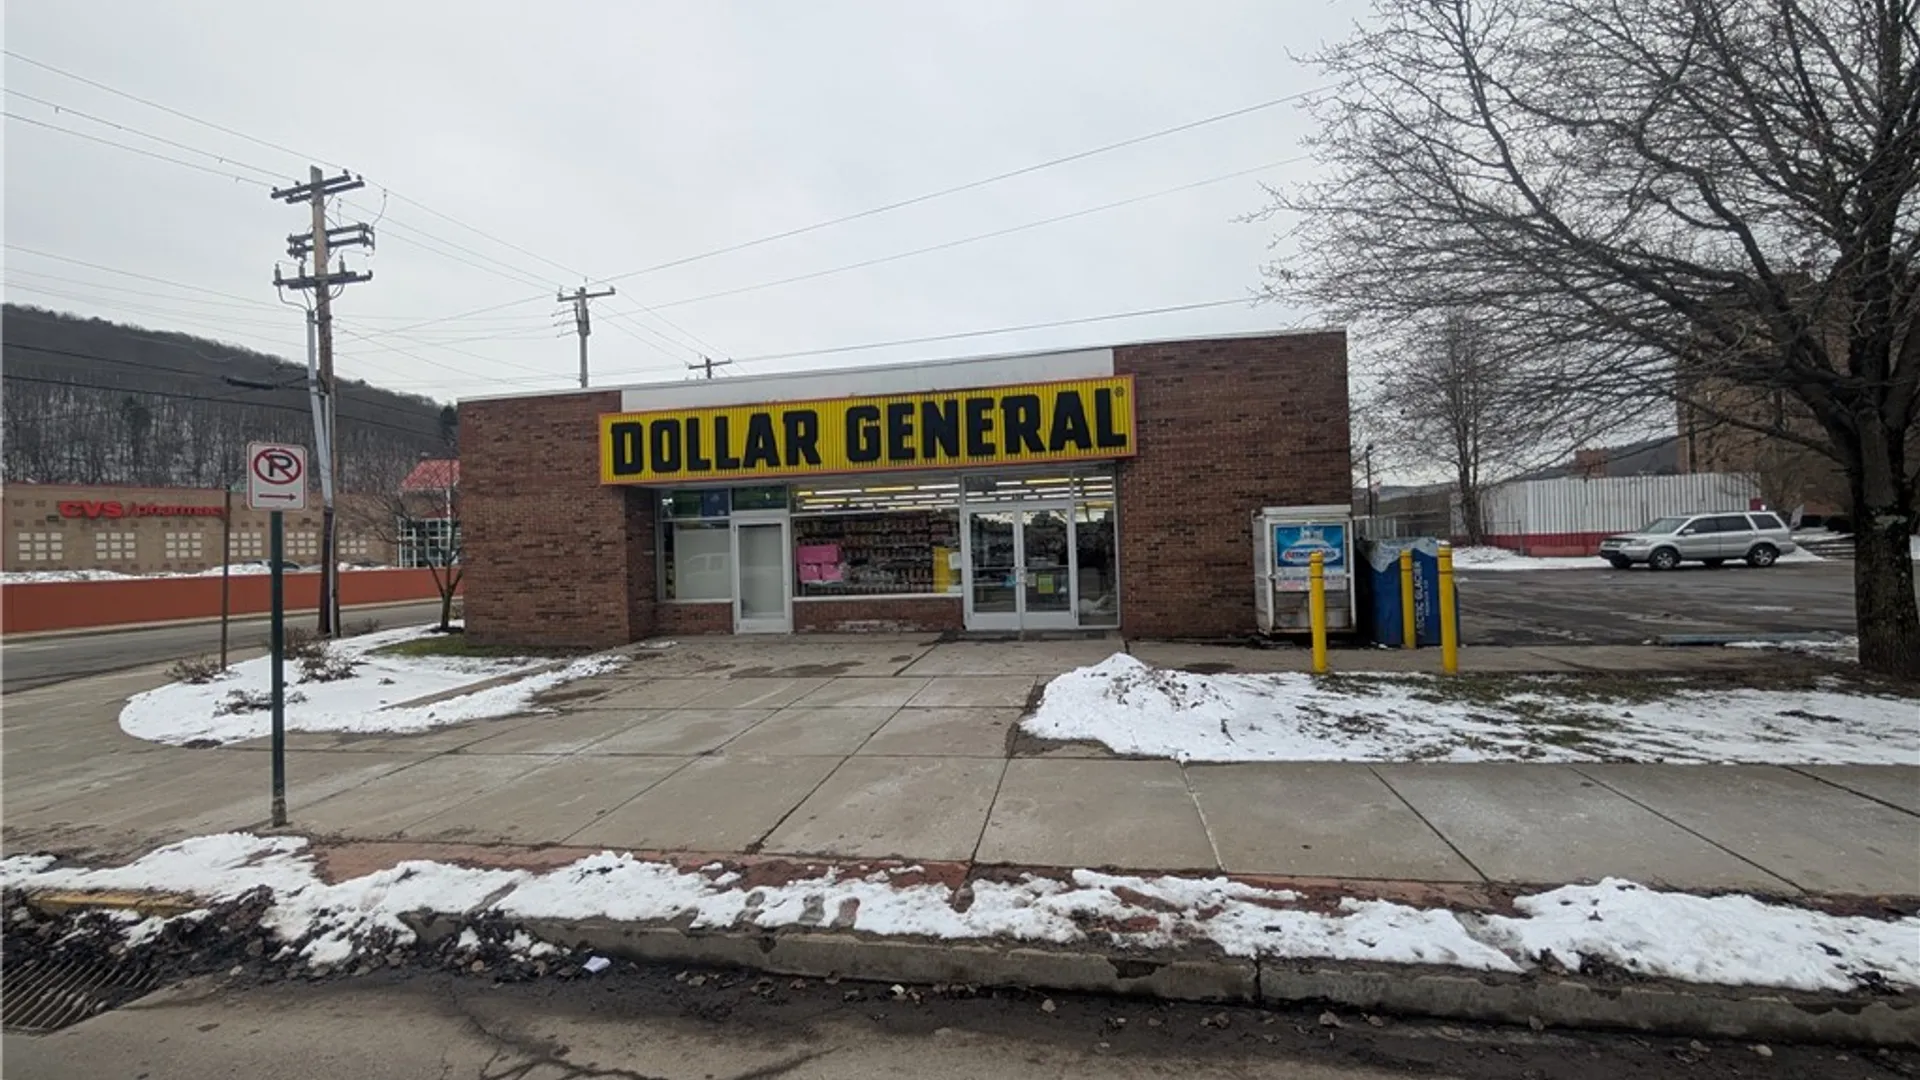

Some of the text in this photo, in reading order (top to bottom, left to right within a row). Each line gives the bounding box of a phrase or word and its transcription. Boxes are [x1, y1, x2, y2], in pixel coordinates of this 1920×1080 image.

[611, 387, 1127, 476] DOLLAR GENERAL
[1412, 561, 1423, 600] GLACIER
